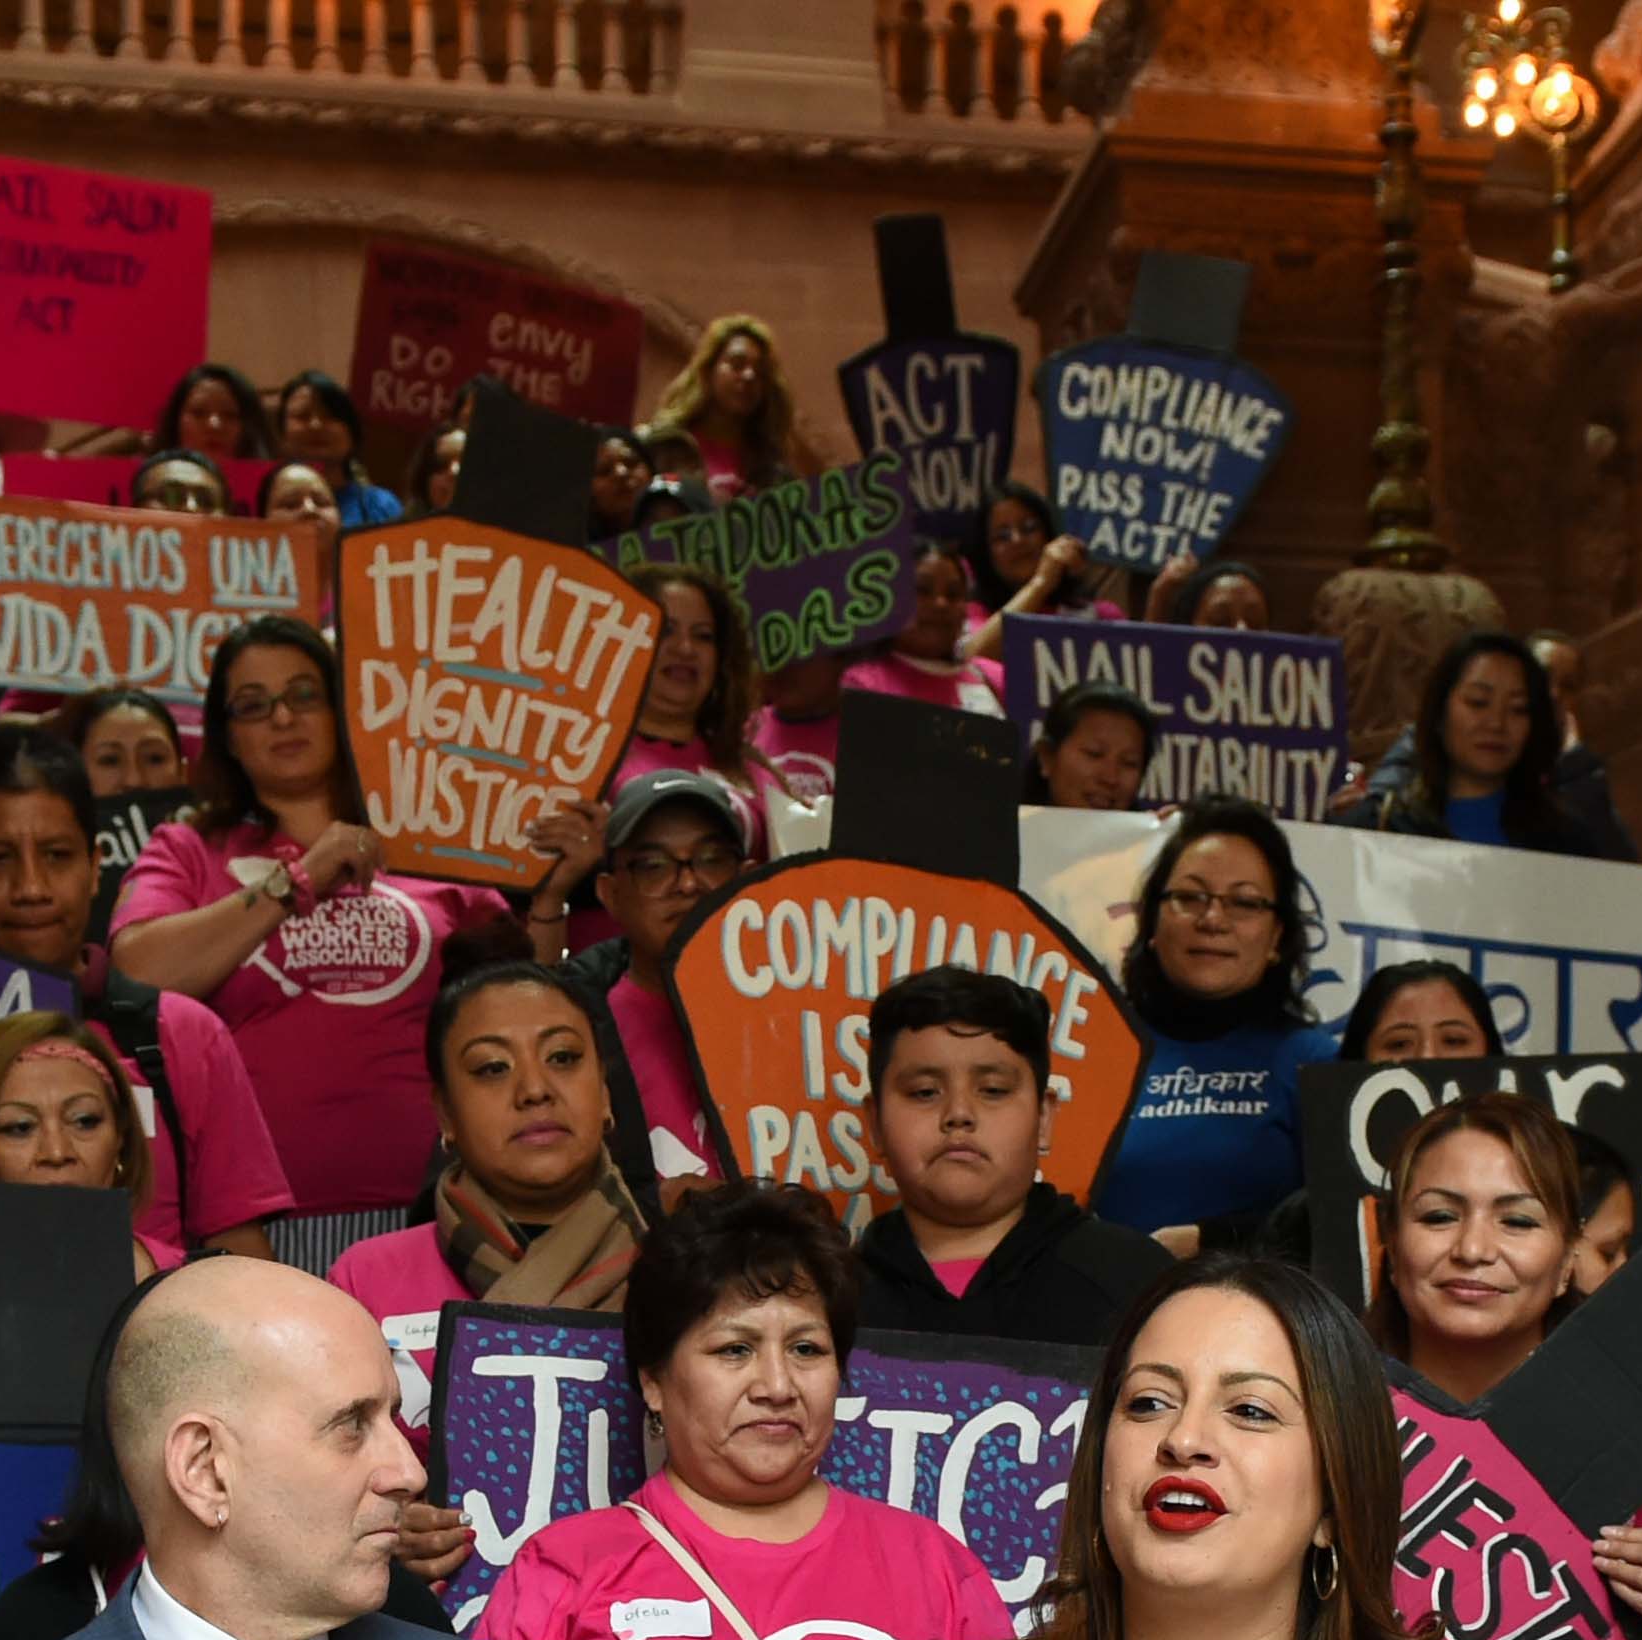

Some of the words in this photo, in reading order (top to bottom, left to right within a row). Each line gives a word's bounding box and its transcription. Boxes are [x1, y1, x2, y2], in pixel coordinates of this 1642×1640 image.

[863, 353, 985, 452] ACT
[1058, 361, 1284, 459] COMPLIANCE
[1100, 424, 1219, 482] NOW!
[1059, 463, 1144, 520] PASS
[1162, 481, 1233, 540] THE
[210, 534, 299, 598] UNA
[367, 539, 654, 718] HEALTH
[360, 658, 610, 780] DIGNITY
[1183, 641, 1334, 731] SALON
[280, 926, 409, 951] WORKERS
[284, 948, 406, 971] ASSOCIATION
[1138, 1096, 1269, 1119] adhikaar
[748, 1103, 899, 1196] PAS
